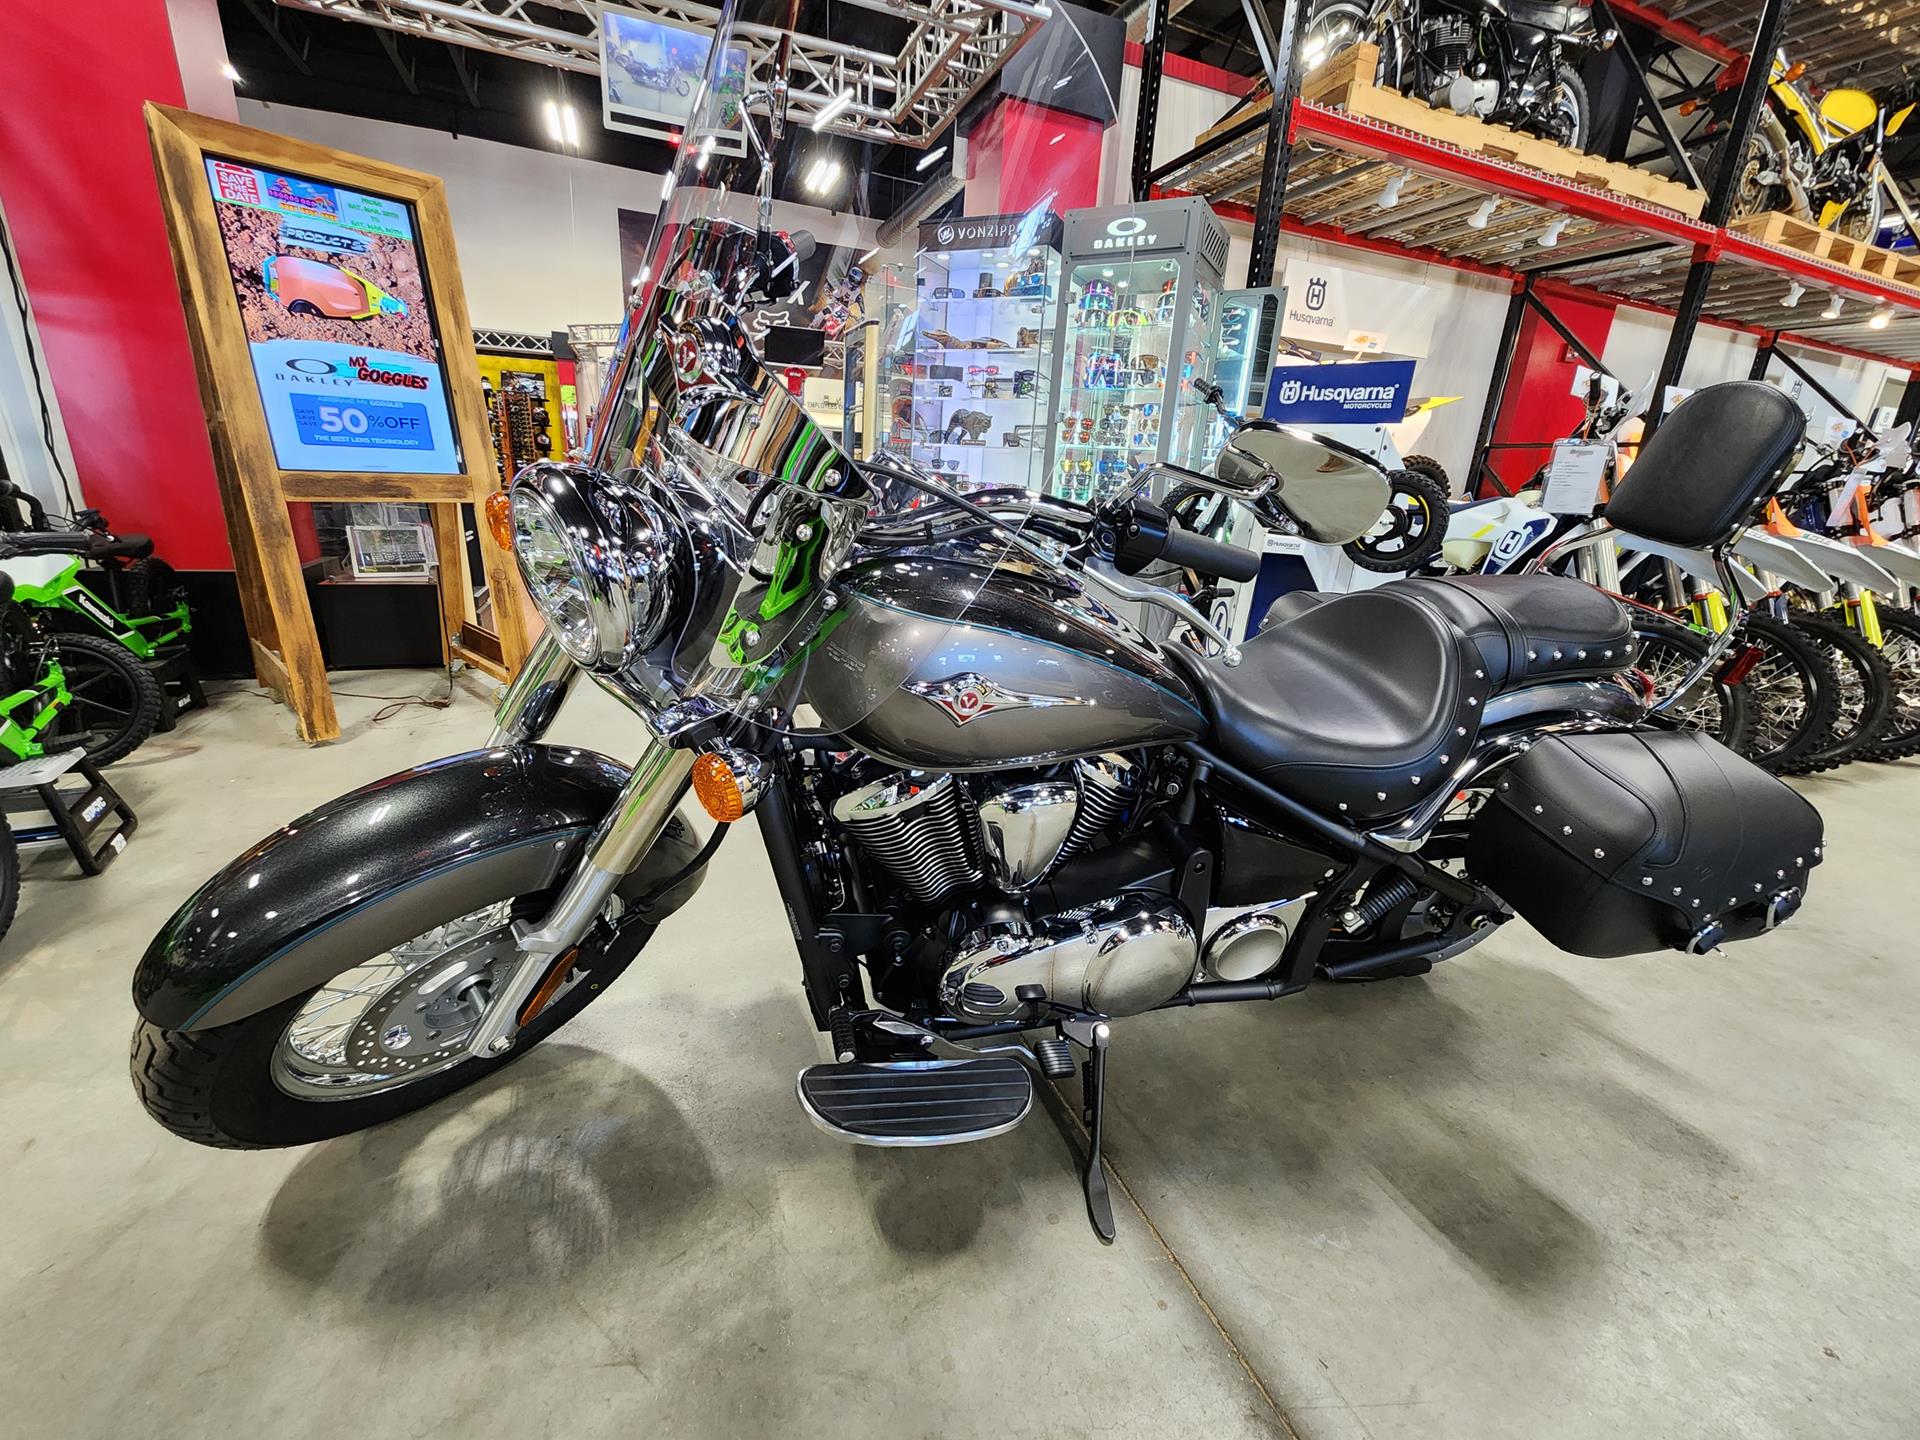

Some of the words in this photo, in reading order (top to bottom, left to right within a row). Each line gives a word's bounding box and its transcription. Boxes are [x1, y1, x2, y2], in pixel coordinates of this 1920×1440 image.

[219, 171, 254, 188] SAVE
[224, 188, 260, 204] DATE
[228, 182, 248, 194] THE
[957, 222, 1017, 240] VONZIPP
[1094, 234, 1158, 249] OAKLEY
[1289, 309, 1335, 327] Husqvarna
[348, 356, 369, 368] MX
[275, 373, 354, 387] OAKLEY
[357, 367, 430, 390] GOGGLES
[1300, 383, 1395, 404] Husqvarna
[1343, 402, 1393, 410] MOTORCYCLES
[319, 405, 369, 434] 50
[313, 434, 330, 442] THE
[370, 437, 419, 446] TECHNOLOGY
